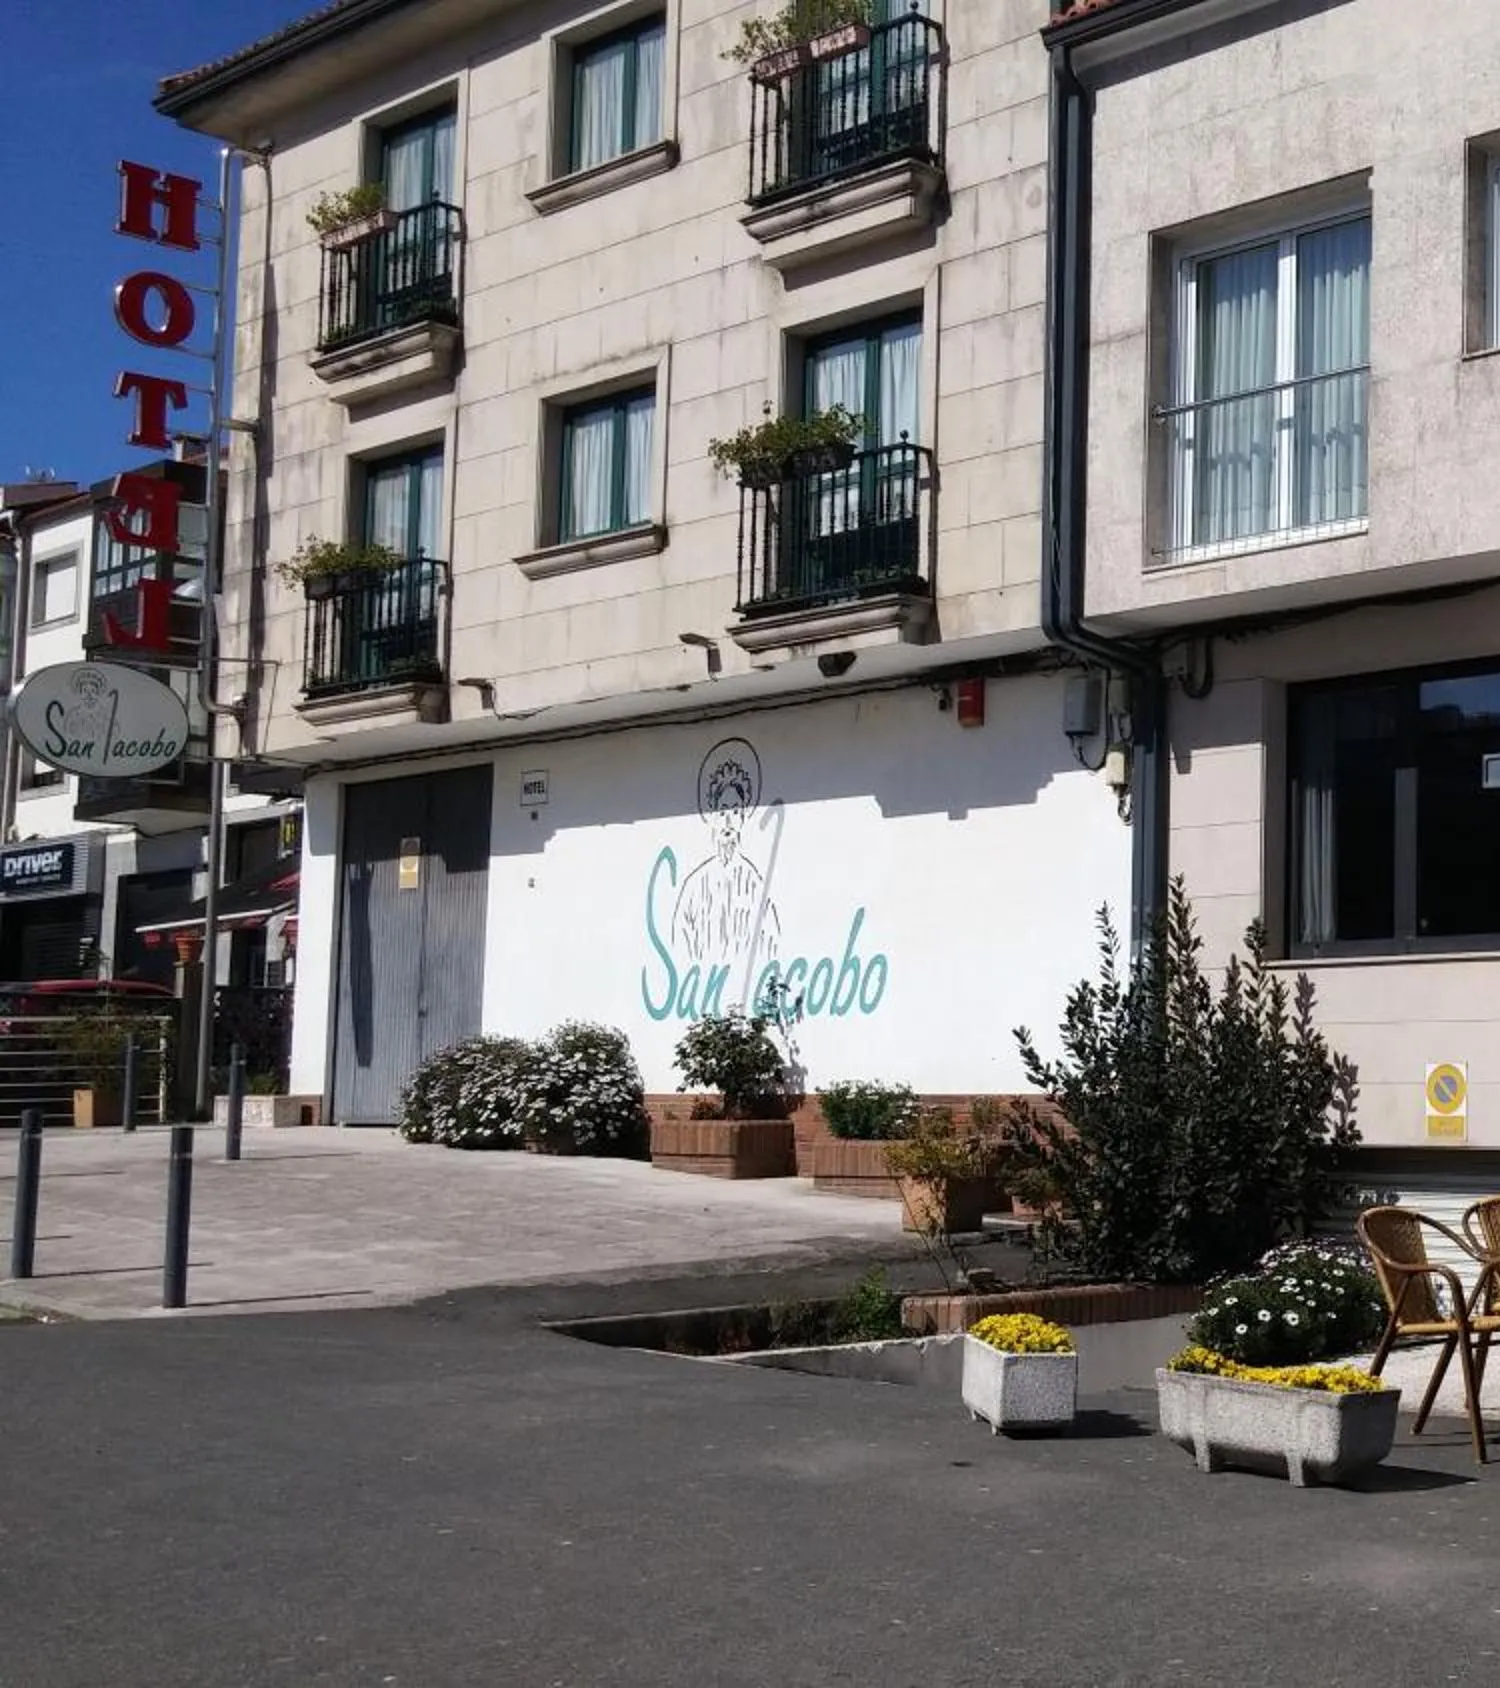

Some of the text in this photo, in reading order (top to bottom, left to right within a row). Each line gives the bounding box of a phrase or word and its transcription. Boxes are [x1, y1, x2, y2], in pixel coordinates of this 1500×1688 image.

[45, 700, 96, 758] San
[523, 780, 545, 795] HOTEL
[641, 845, 730, 1021] San
